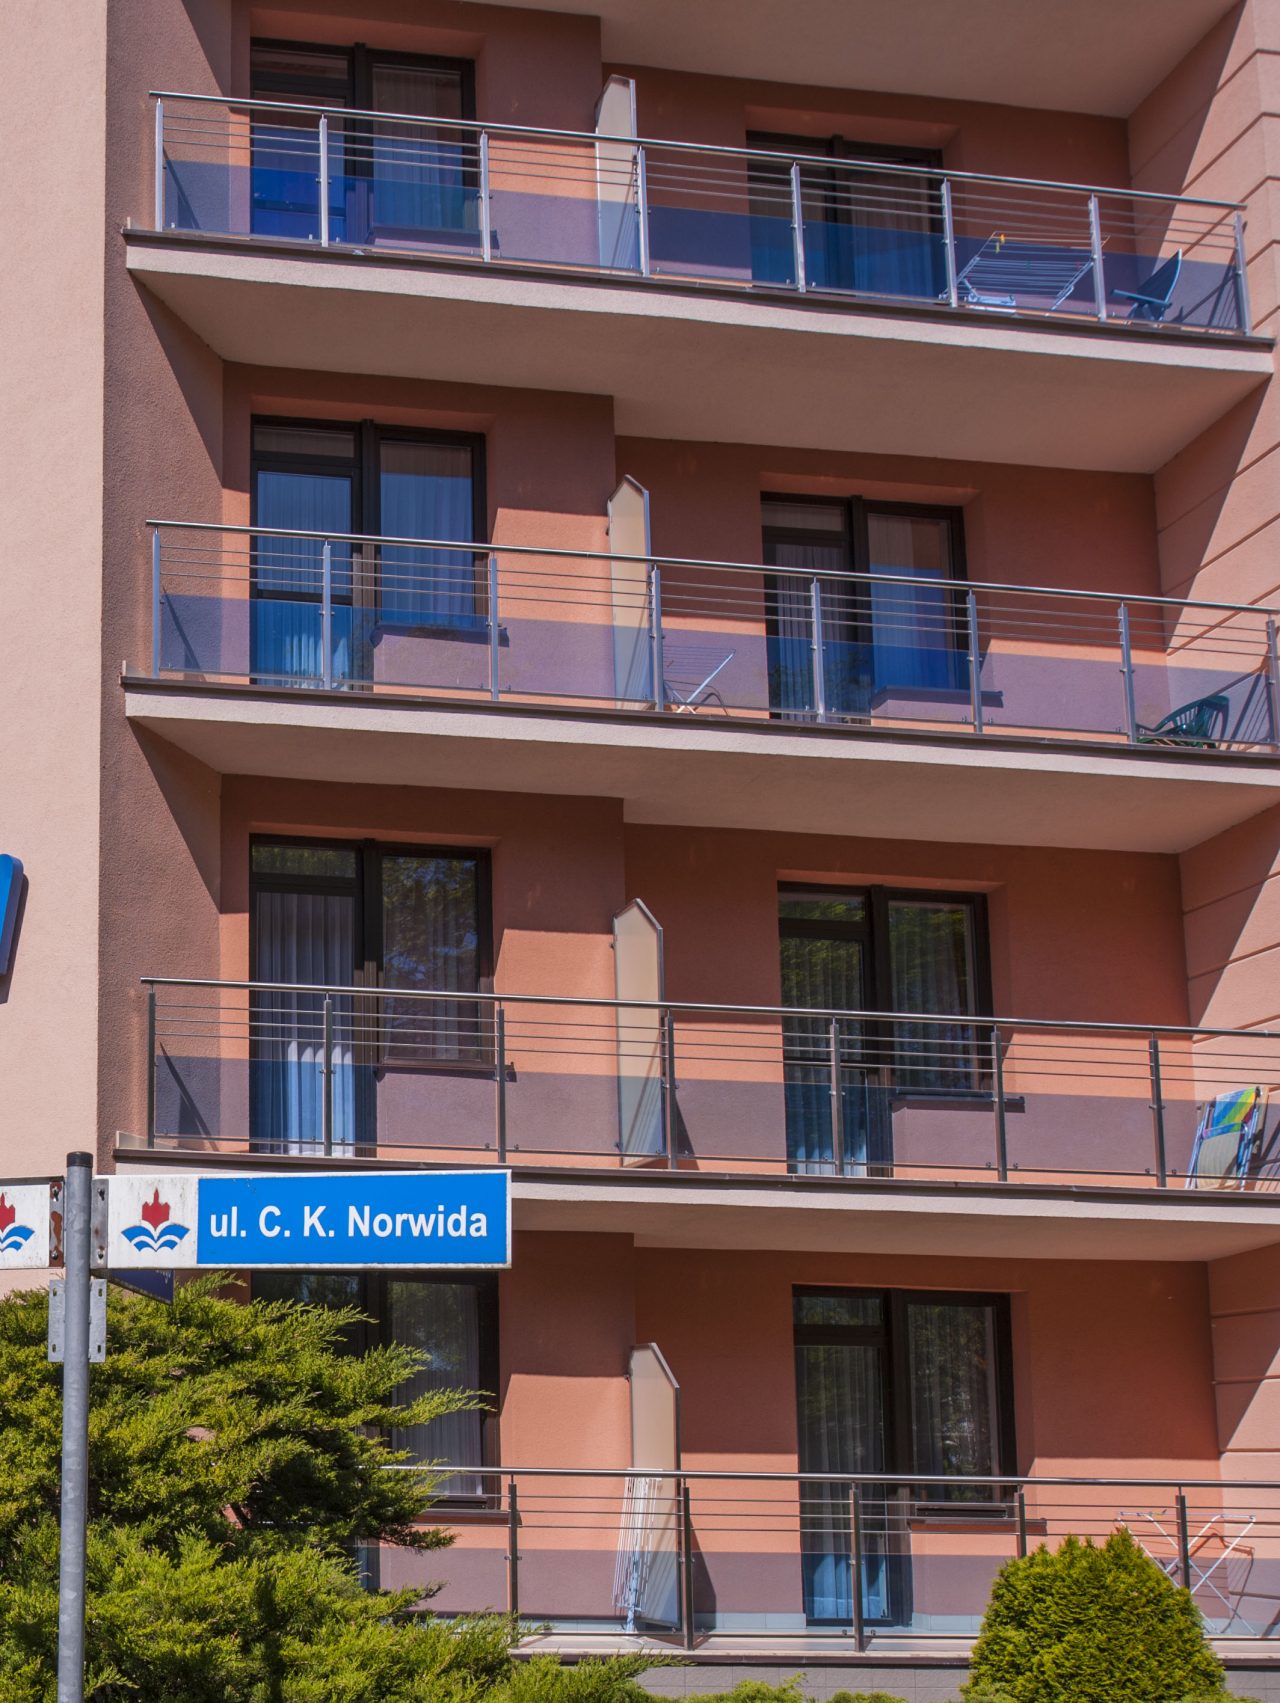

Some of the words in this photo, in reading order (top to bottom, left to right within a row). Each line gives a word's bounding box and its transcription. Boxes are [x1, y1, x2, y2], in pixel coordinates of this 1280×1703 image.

[210, 1206, 247, 1238] ul.
[258, 1205, 291, 1238] C.
[303, 1205, 335, 1238] K.
[348, 1204, 488, 1238] Norwida
